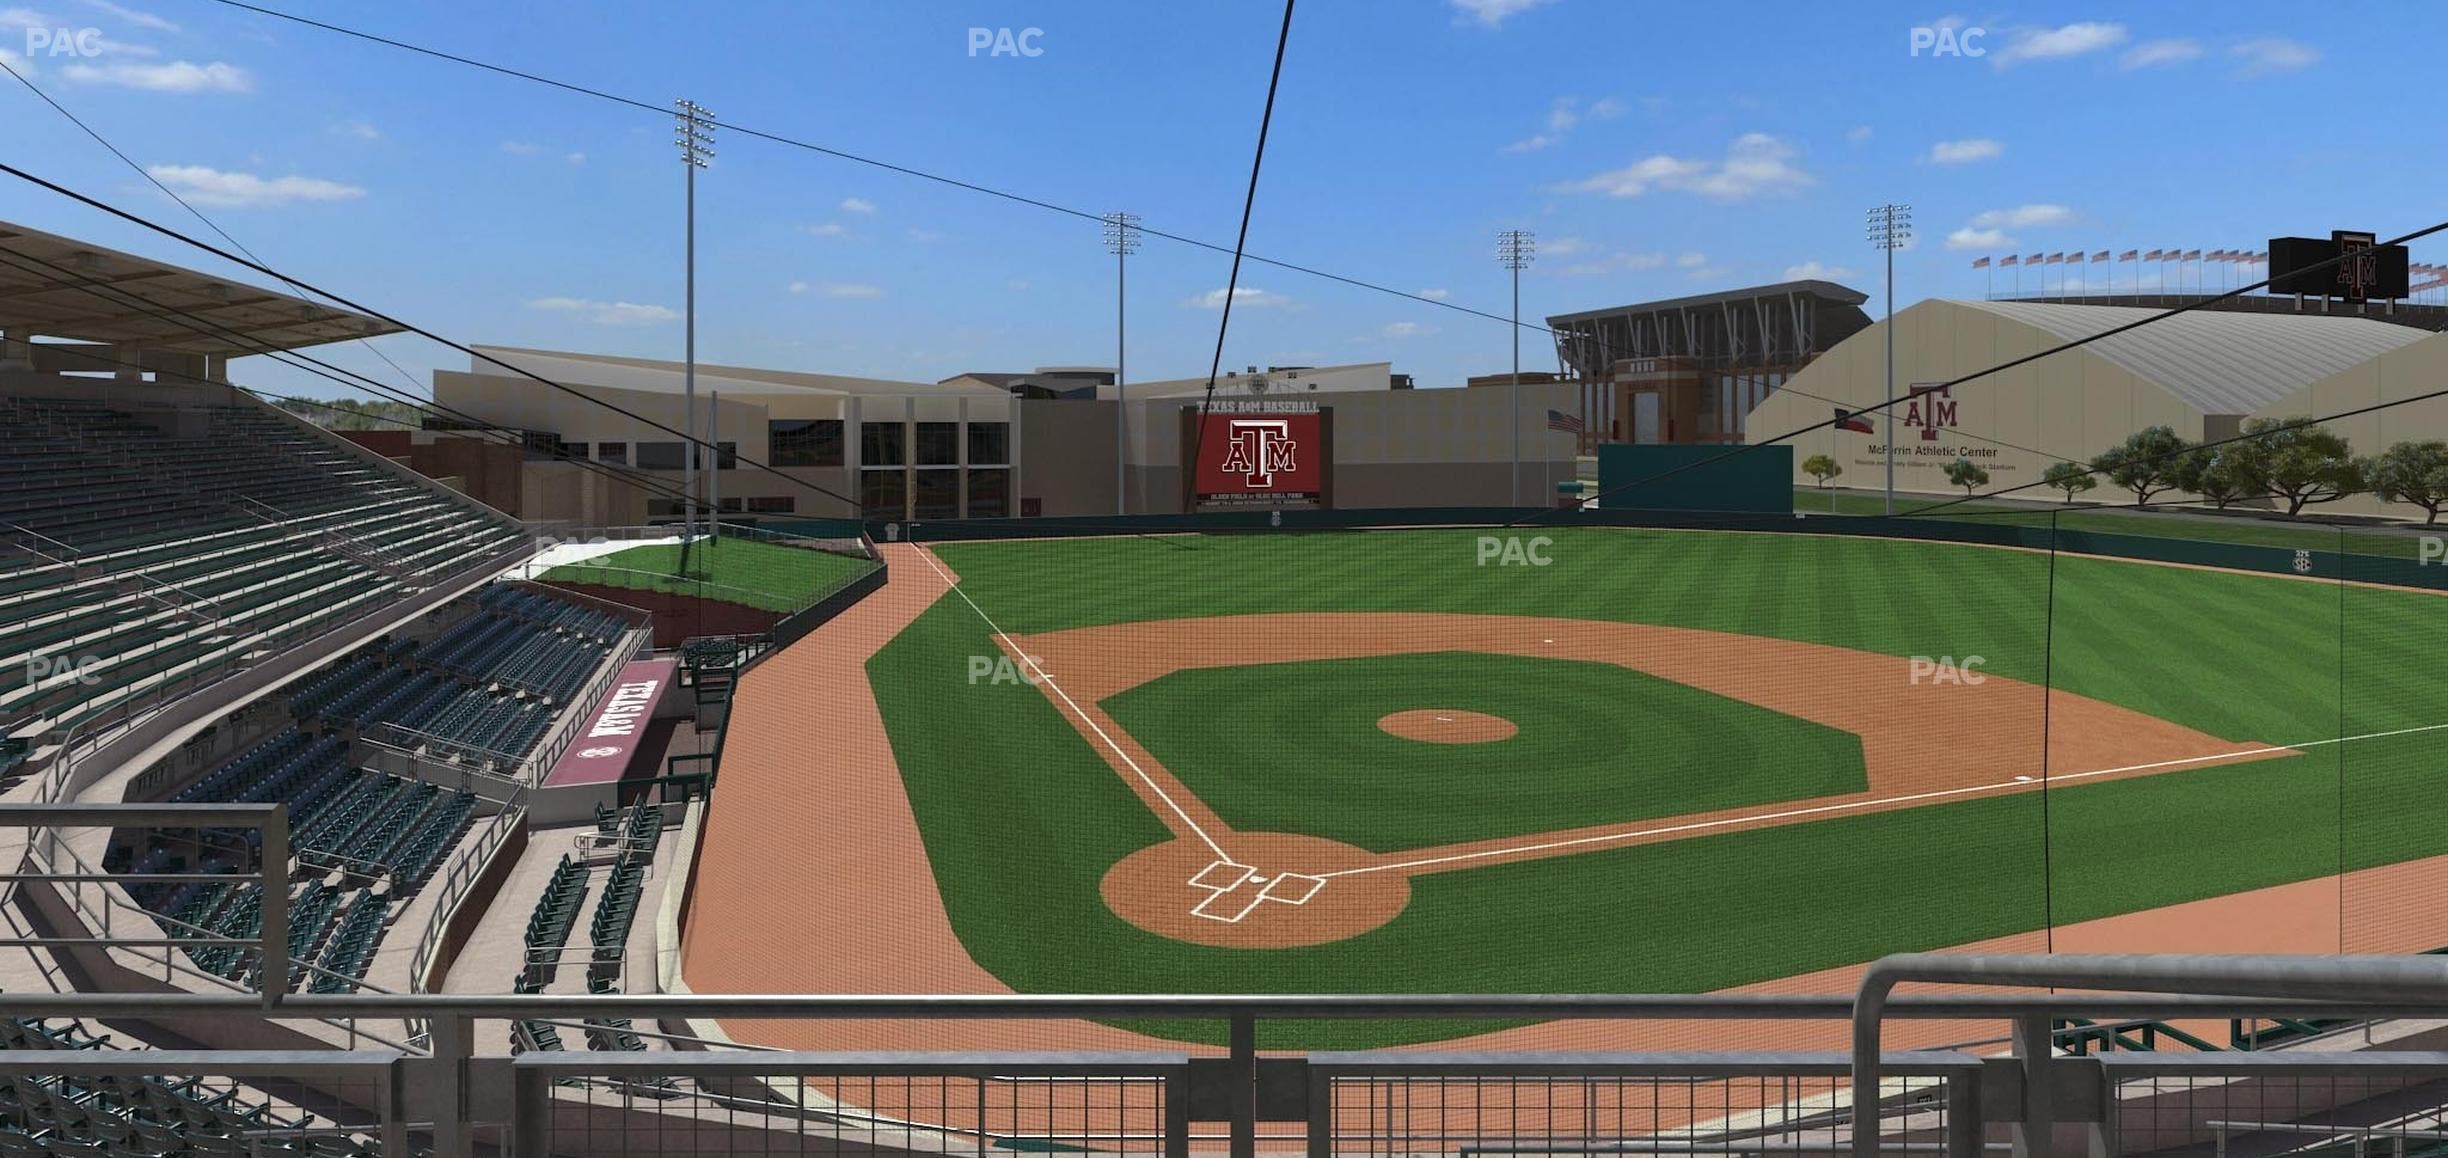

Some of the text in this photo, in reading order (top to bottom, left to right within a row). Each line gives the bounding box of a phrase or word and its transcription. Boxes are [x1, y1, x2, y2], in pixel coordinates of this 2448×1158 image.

[1263, 401, 1320, 413] BASEBALL
[1868, 444, 1998, 458] McFrrin Athletic Center
[604, 680, 659, 714] TEXAS
